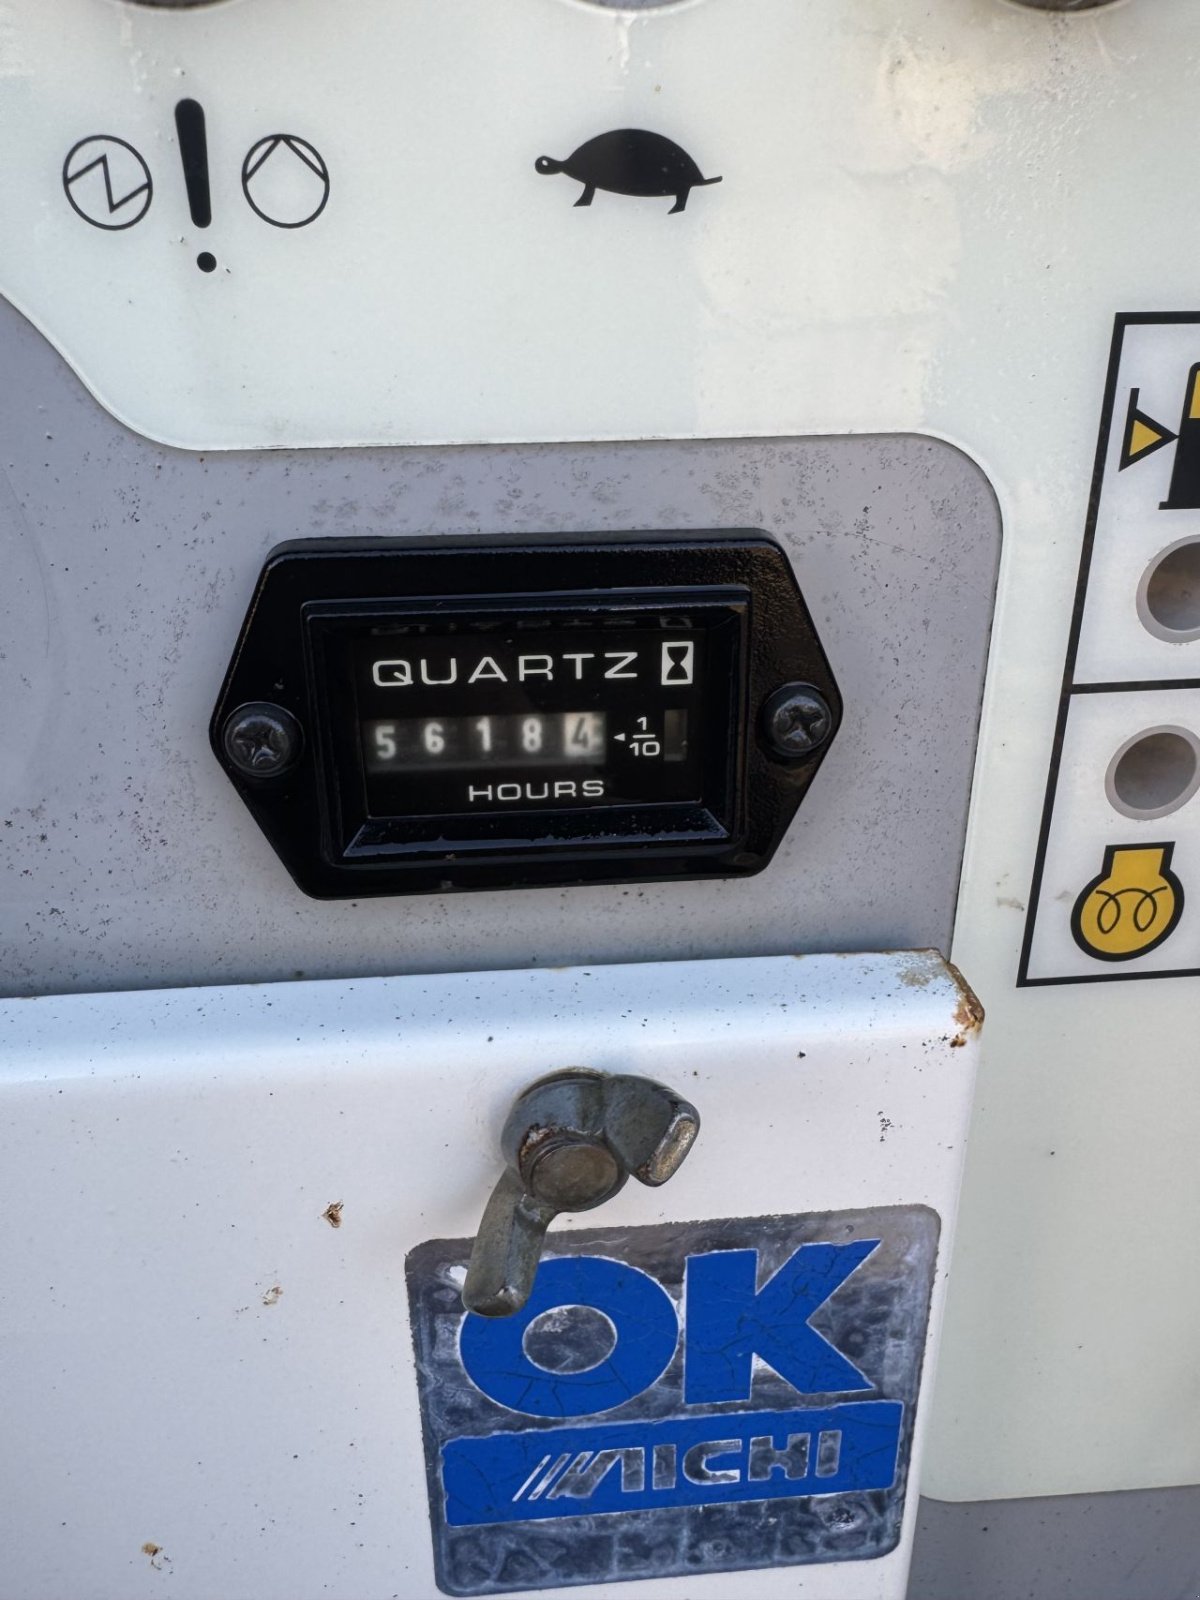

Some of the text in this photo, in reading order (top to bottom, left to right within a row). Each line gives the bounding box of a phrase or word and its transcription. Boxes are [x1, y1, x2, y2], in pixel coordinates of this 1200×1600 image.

[372, 651, 639, 687] QUARTZ
[468, 780, 605, 802] HOURS
[459, 1238, 881, 1419] OK
